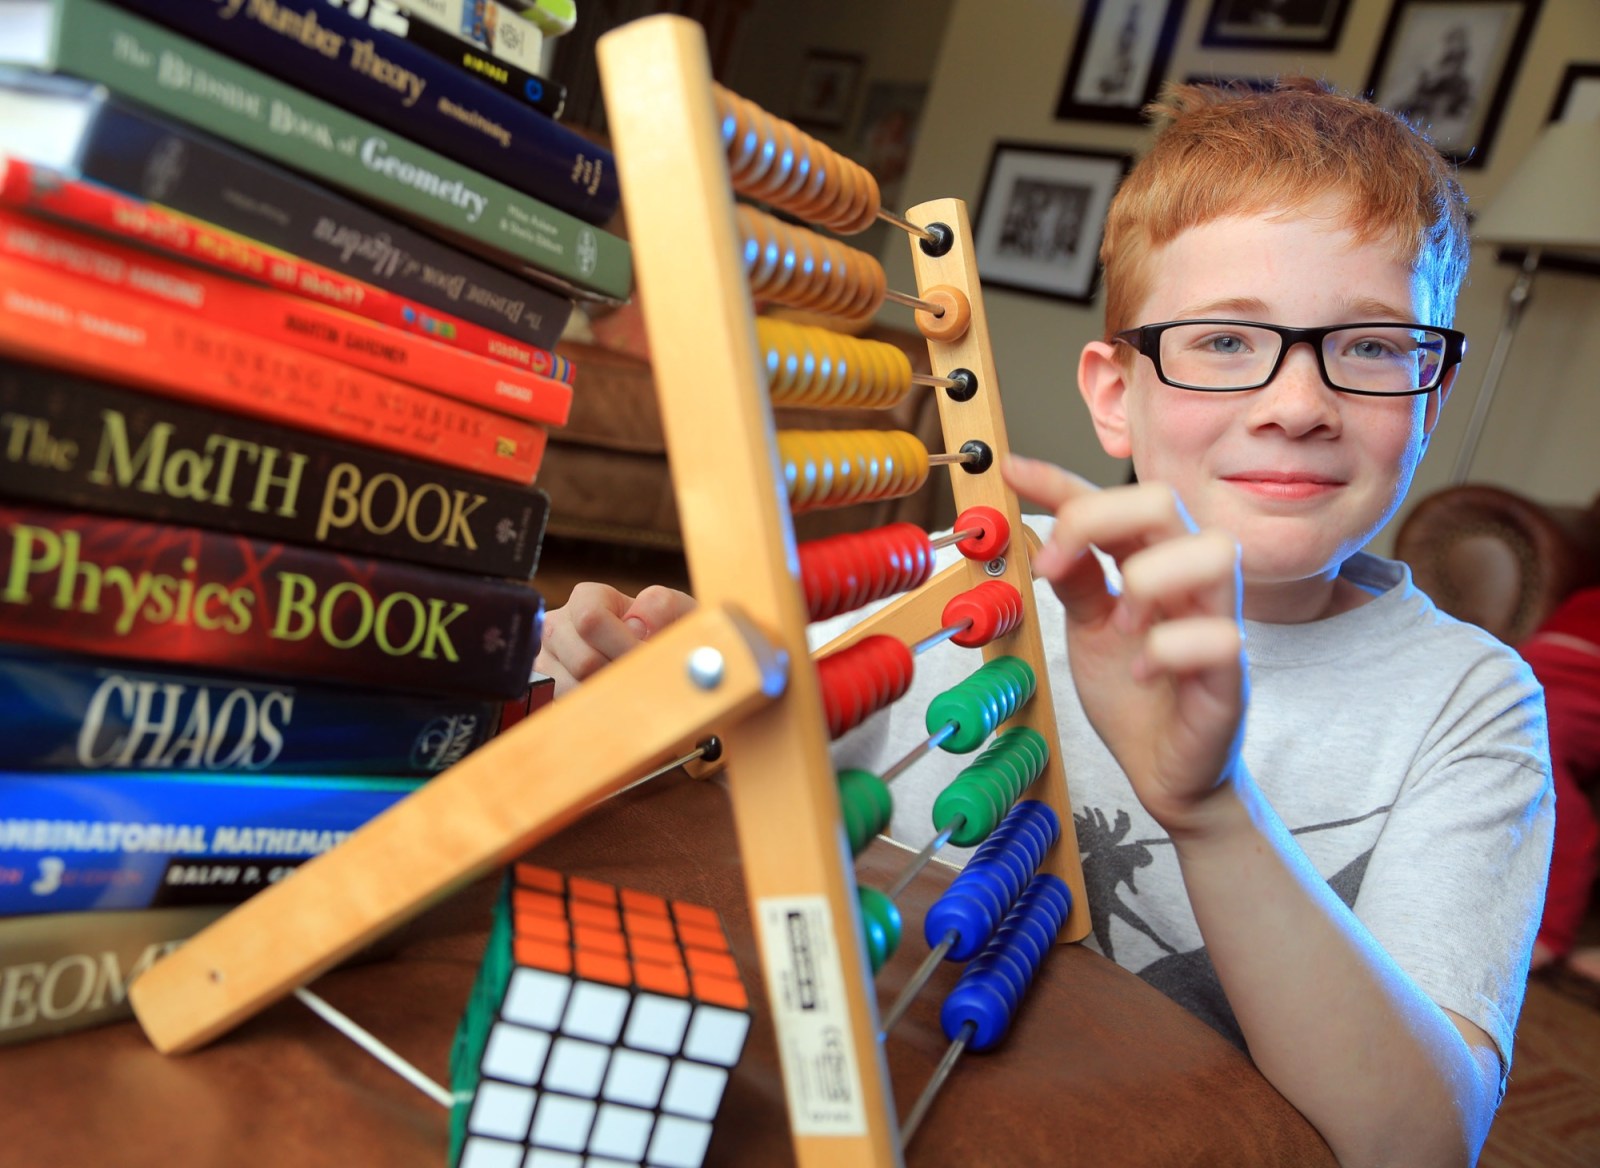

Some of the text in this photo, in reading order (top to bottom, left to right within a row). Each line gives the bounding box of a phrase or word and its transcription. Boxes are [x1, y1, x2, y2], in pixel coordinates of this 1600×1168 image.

[349, 37, 428, 108] Theory
[112, 31, 153, 68] The
[361, 135, 489, 223] Geometry
[313, 215, 403, 280] Algebra
[4, 411, 80, 472] The
[270, 570, 470, 662] BOOK
[76, 674, 295, 770] CHAOS
[31, 855, 66, 896] 3
